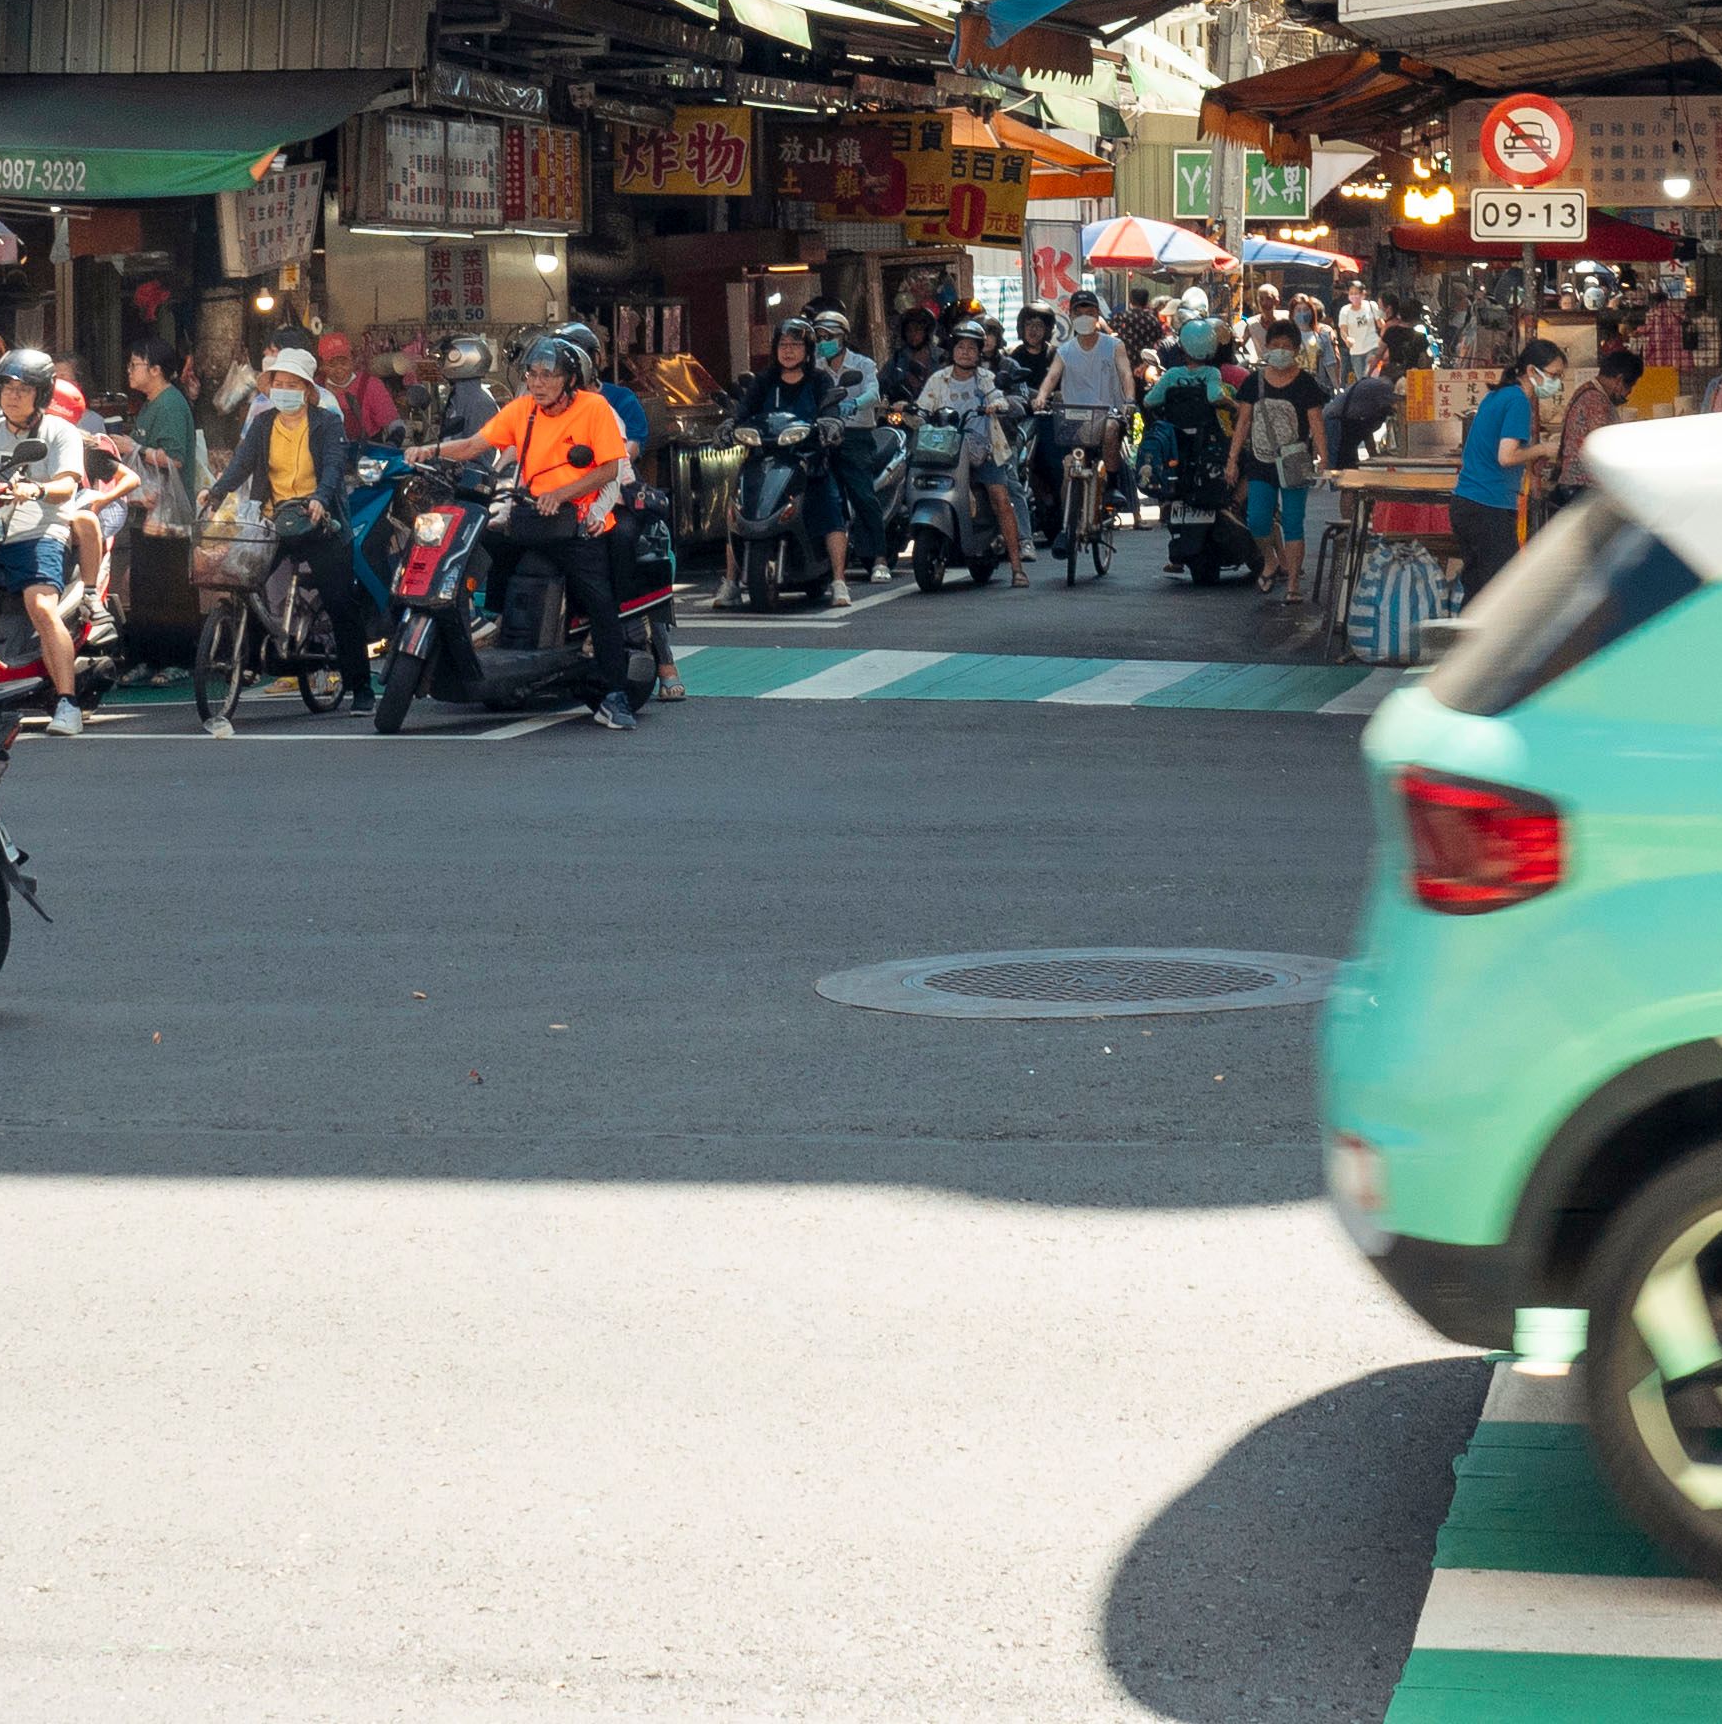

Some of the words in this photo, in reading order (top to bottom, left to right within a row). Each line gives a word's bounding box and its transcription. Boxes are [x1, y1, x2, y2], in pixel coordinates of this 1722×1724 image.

[778, 136, 864, 166] 放山雞
[877, 119, 945, 153] 百貨
[620, 121, 748, 188] 炸物
[1481, 201, 1577, 228] 09-13
[431, 248, 453, 307] 甜不辣
[465, 307, 484, 321] 50
